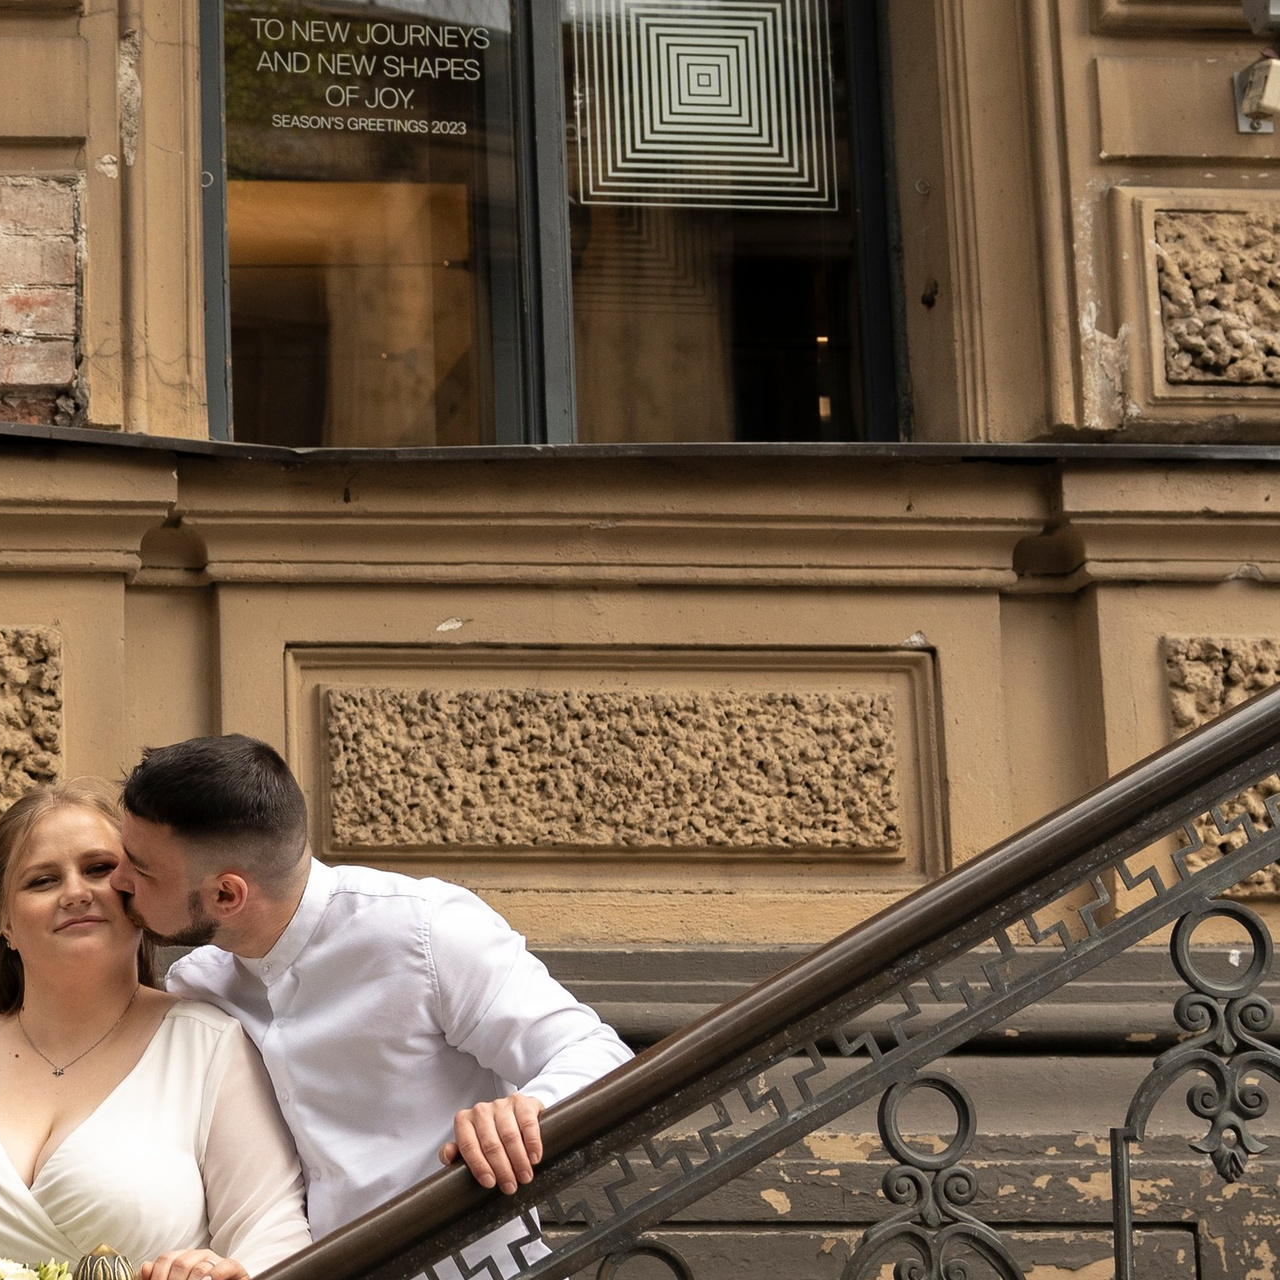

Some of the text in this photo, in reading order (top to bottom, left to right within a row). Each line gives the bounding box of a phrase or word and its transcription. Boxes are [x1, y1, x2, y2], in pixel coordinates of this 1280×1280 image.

[250, 17, 490, 50] TO NEW JOURNEYS
[256, 50, 481, 81] AND NEW SHAPES
[325, 84, 415, 110] OF JOY.
[272, 114, 467, 135] SEASON'S GREETINGS 2023
